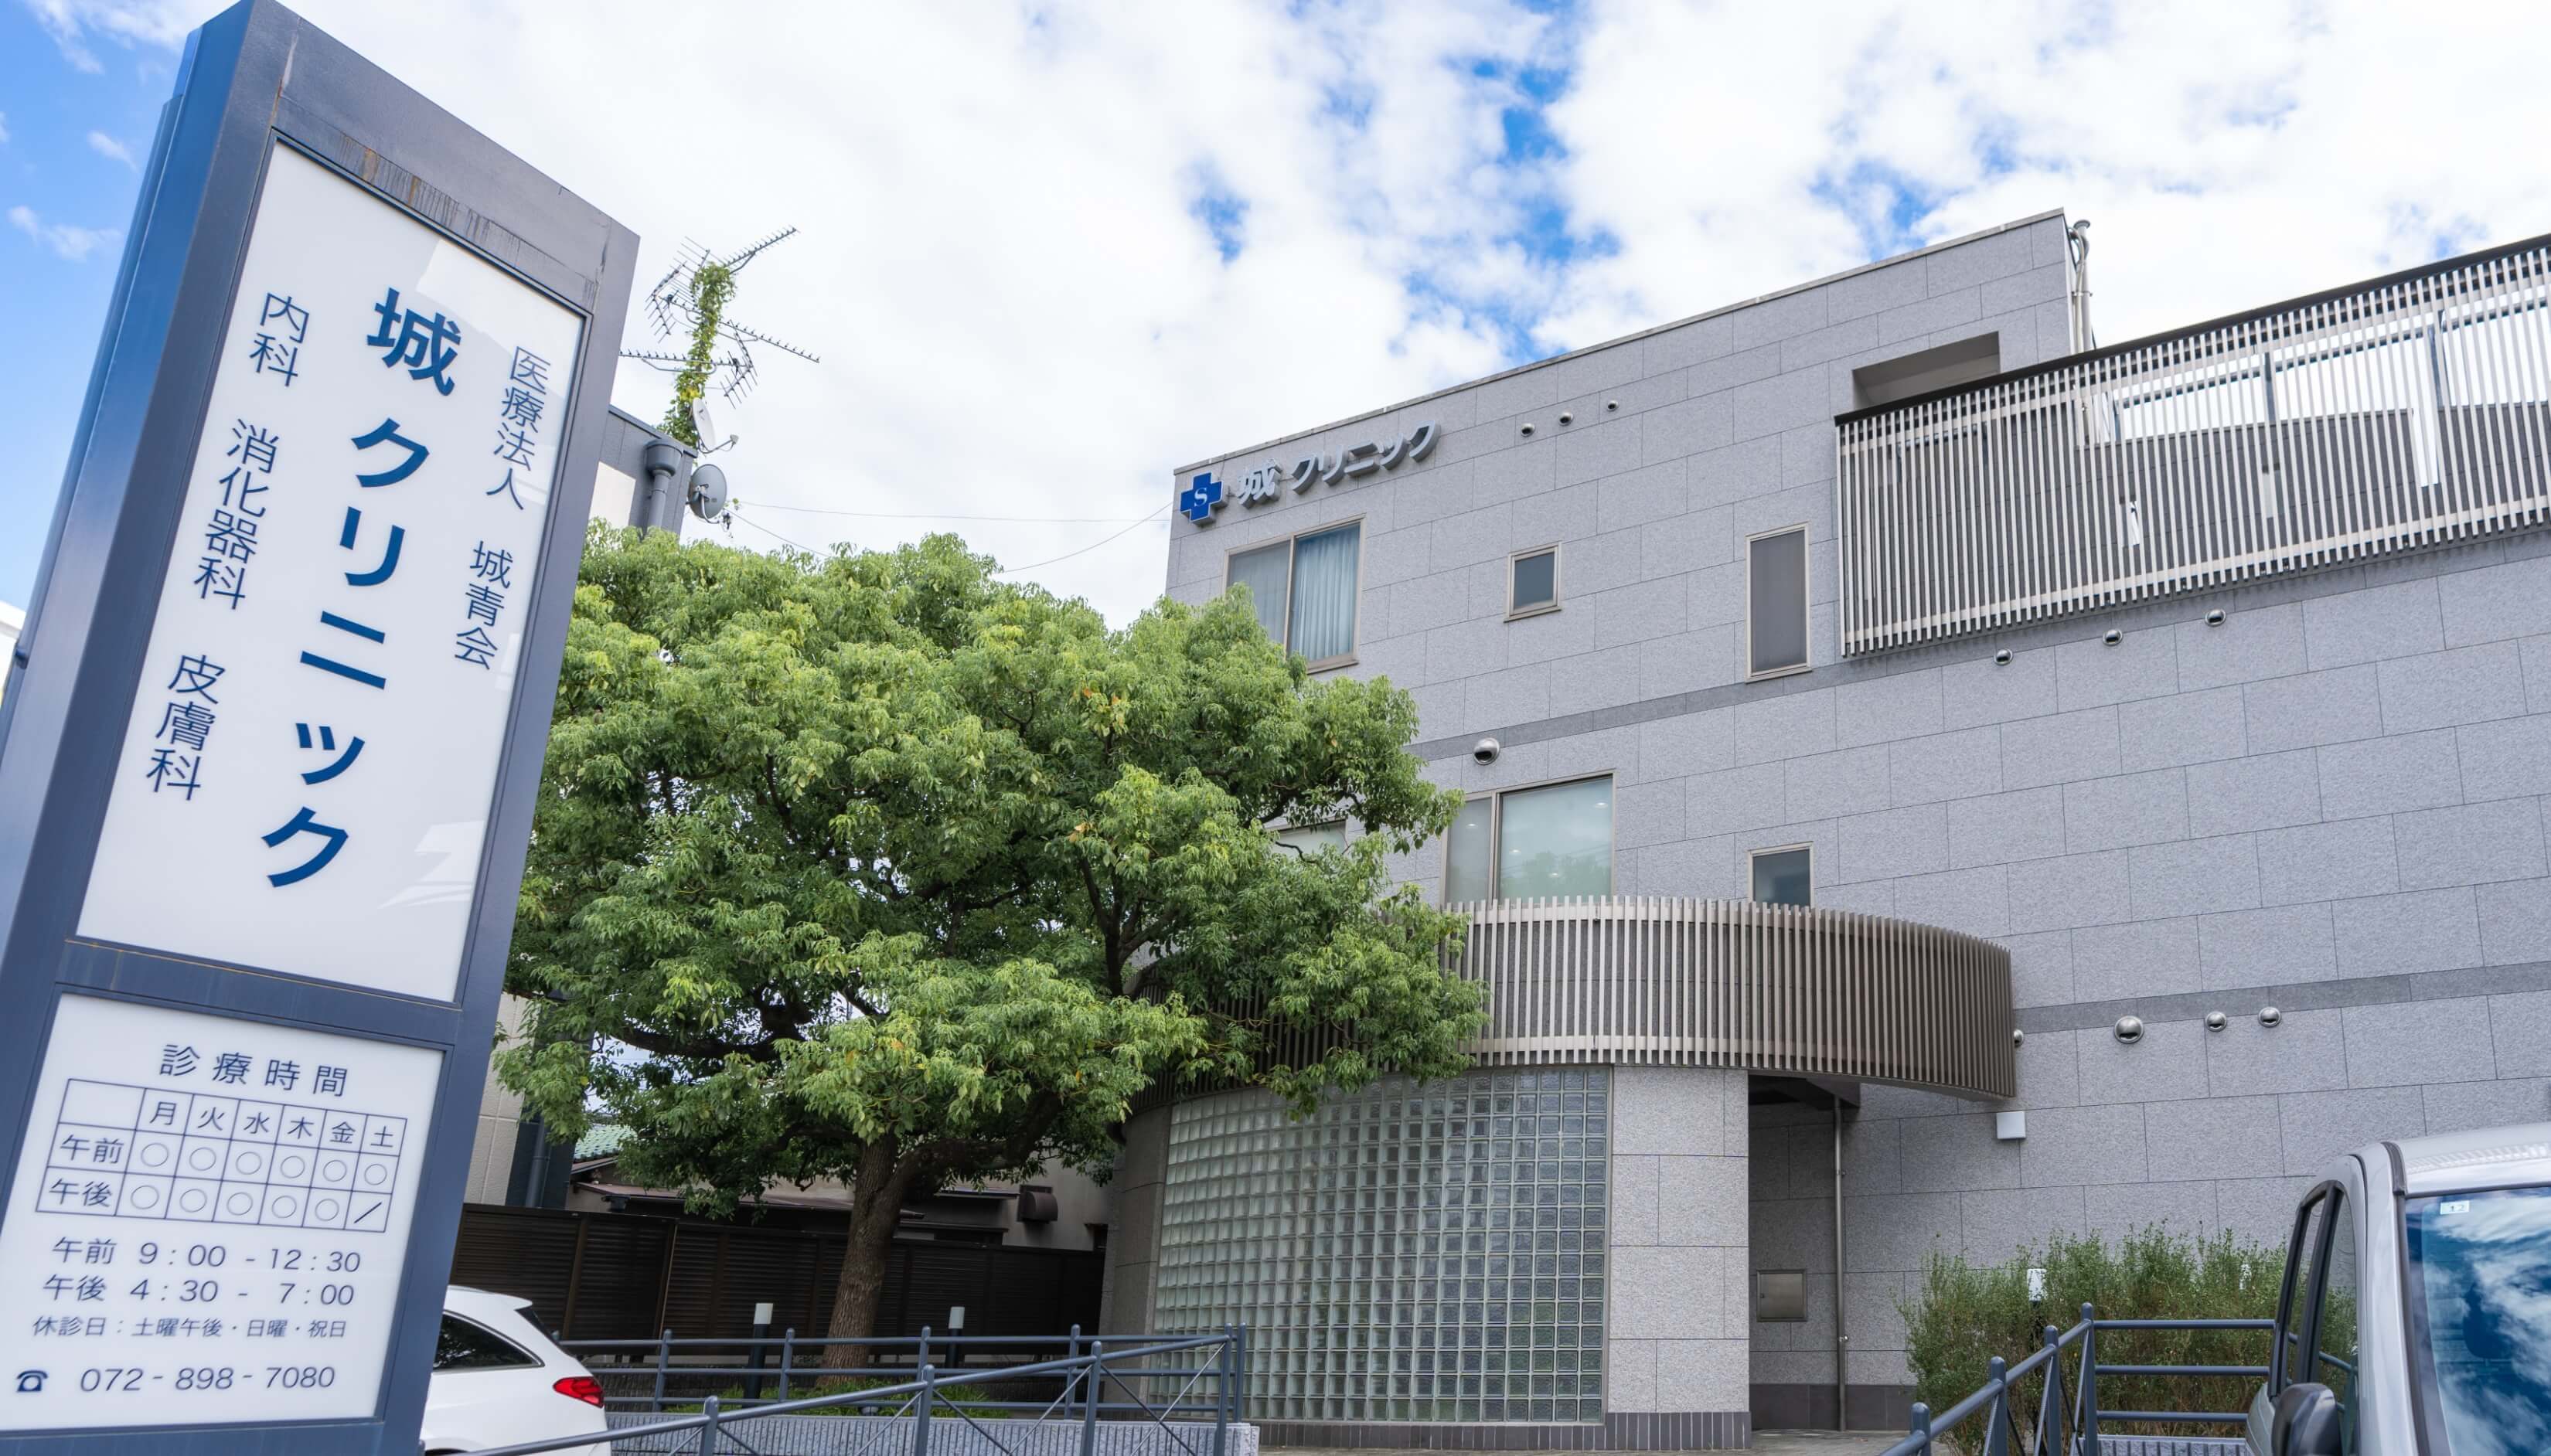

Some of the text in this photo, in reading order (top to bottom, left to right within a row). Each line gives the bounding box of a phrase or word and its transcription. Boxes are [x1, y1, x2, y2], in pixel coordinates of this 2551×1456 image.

[1237, 420, 1441, 509] 城 クリニック
[454, 345, 550, 671] 医療法人 城青会
[1194, 487, 1207, 507] S
[145, 292, 310, 801] 内科 消化器科 皮膚科
[261, 287, 461, 889] 城 クリニック
[158, 1043, 349, 1098] 診療時間
[149, 1101, 394, 1148] 月 火 水 木 金 土
[60, 1134, 124, 1165] 午前
[48, 1178, 113, 1208] 午後
[52, 1237, 117, 1265] 午前
[43, 1274, 107, 1301] 午後
[80, 1366, 335, 1392] 072-898-7080
